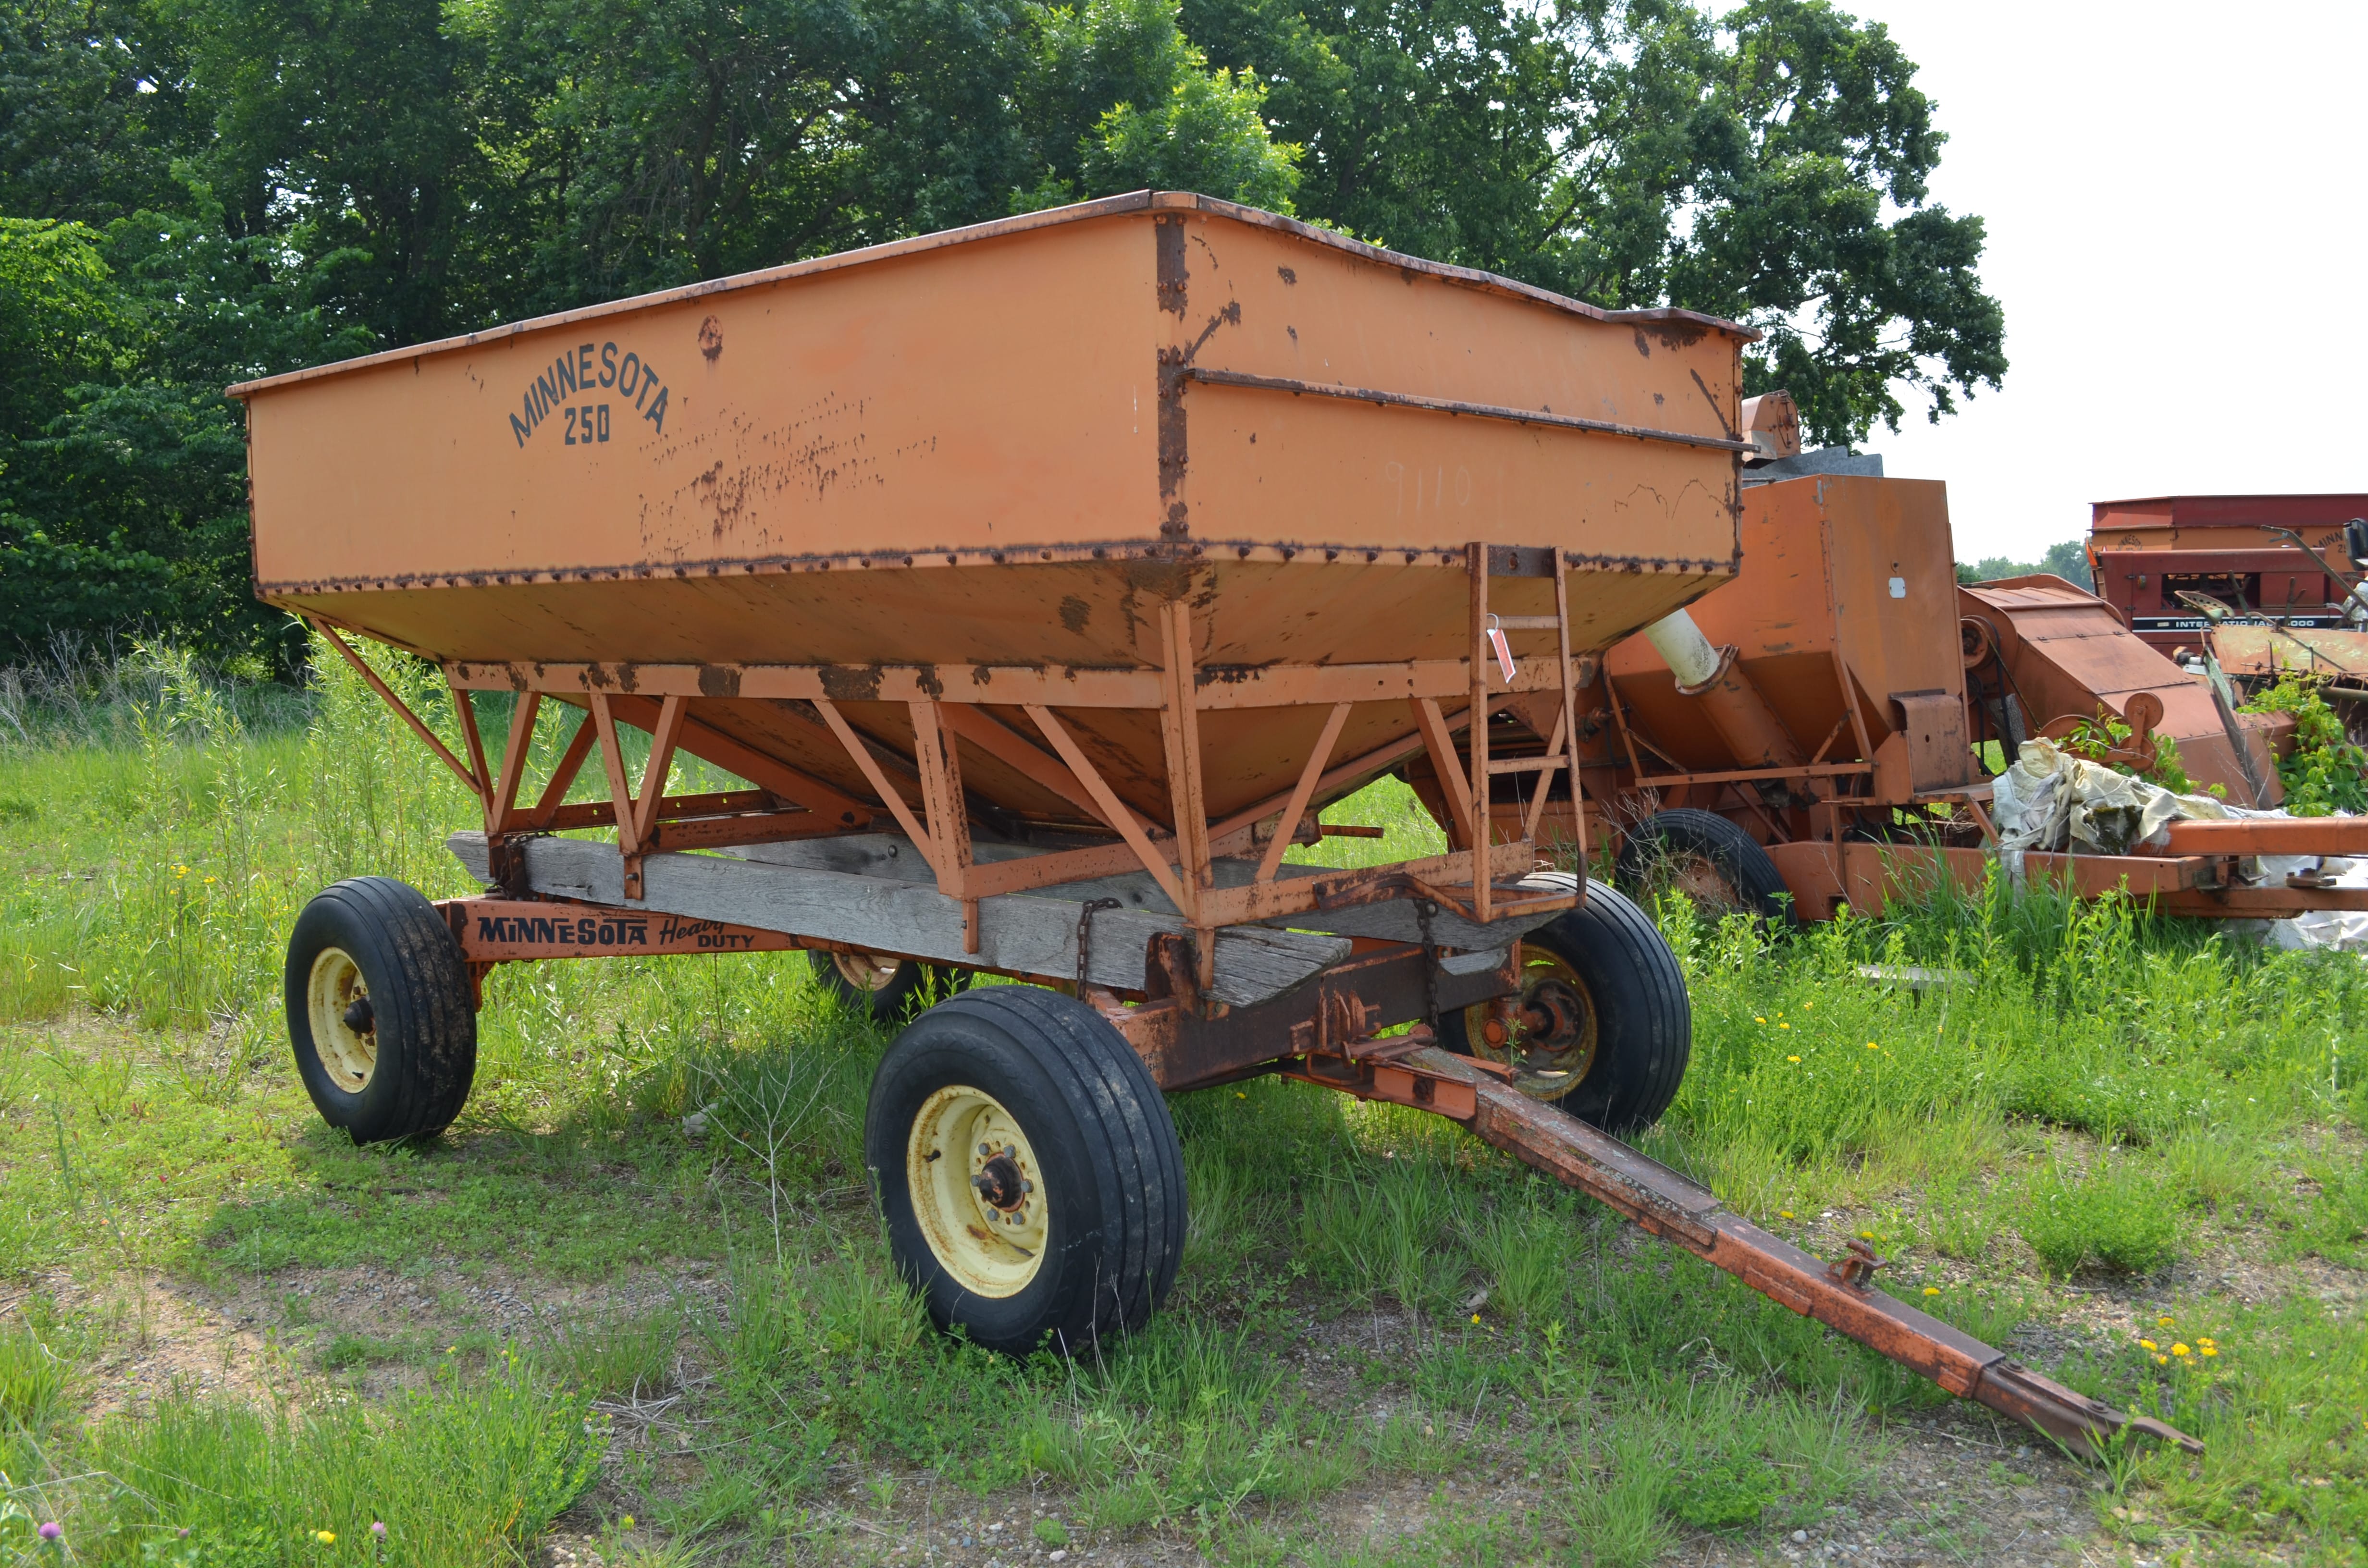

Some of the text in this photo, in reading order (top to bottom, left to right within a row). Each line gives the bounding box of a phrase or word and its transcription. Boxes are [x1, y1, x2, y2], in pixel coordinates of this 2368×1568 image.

[509, 342, 668, 449] MINNESOTA
[565, 404, 609, 445] 250
[698, 935, 755, 948] DUTY
